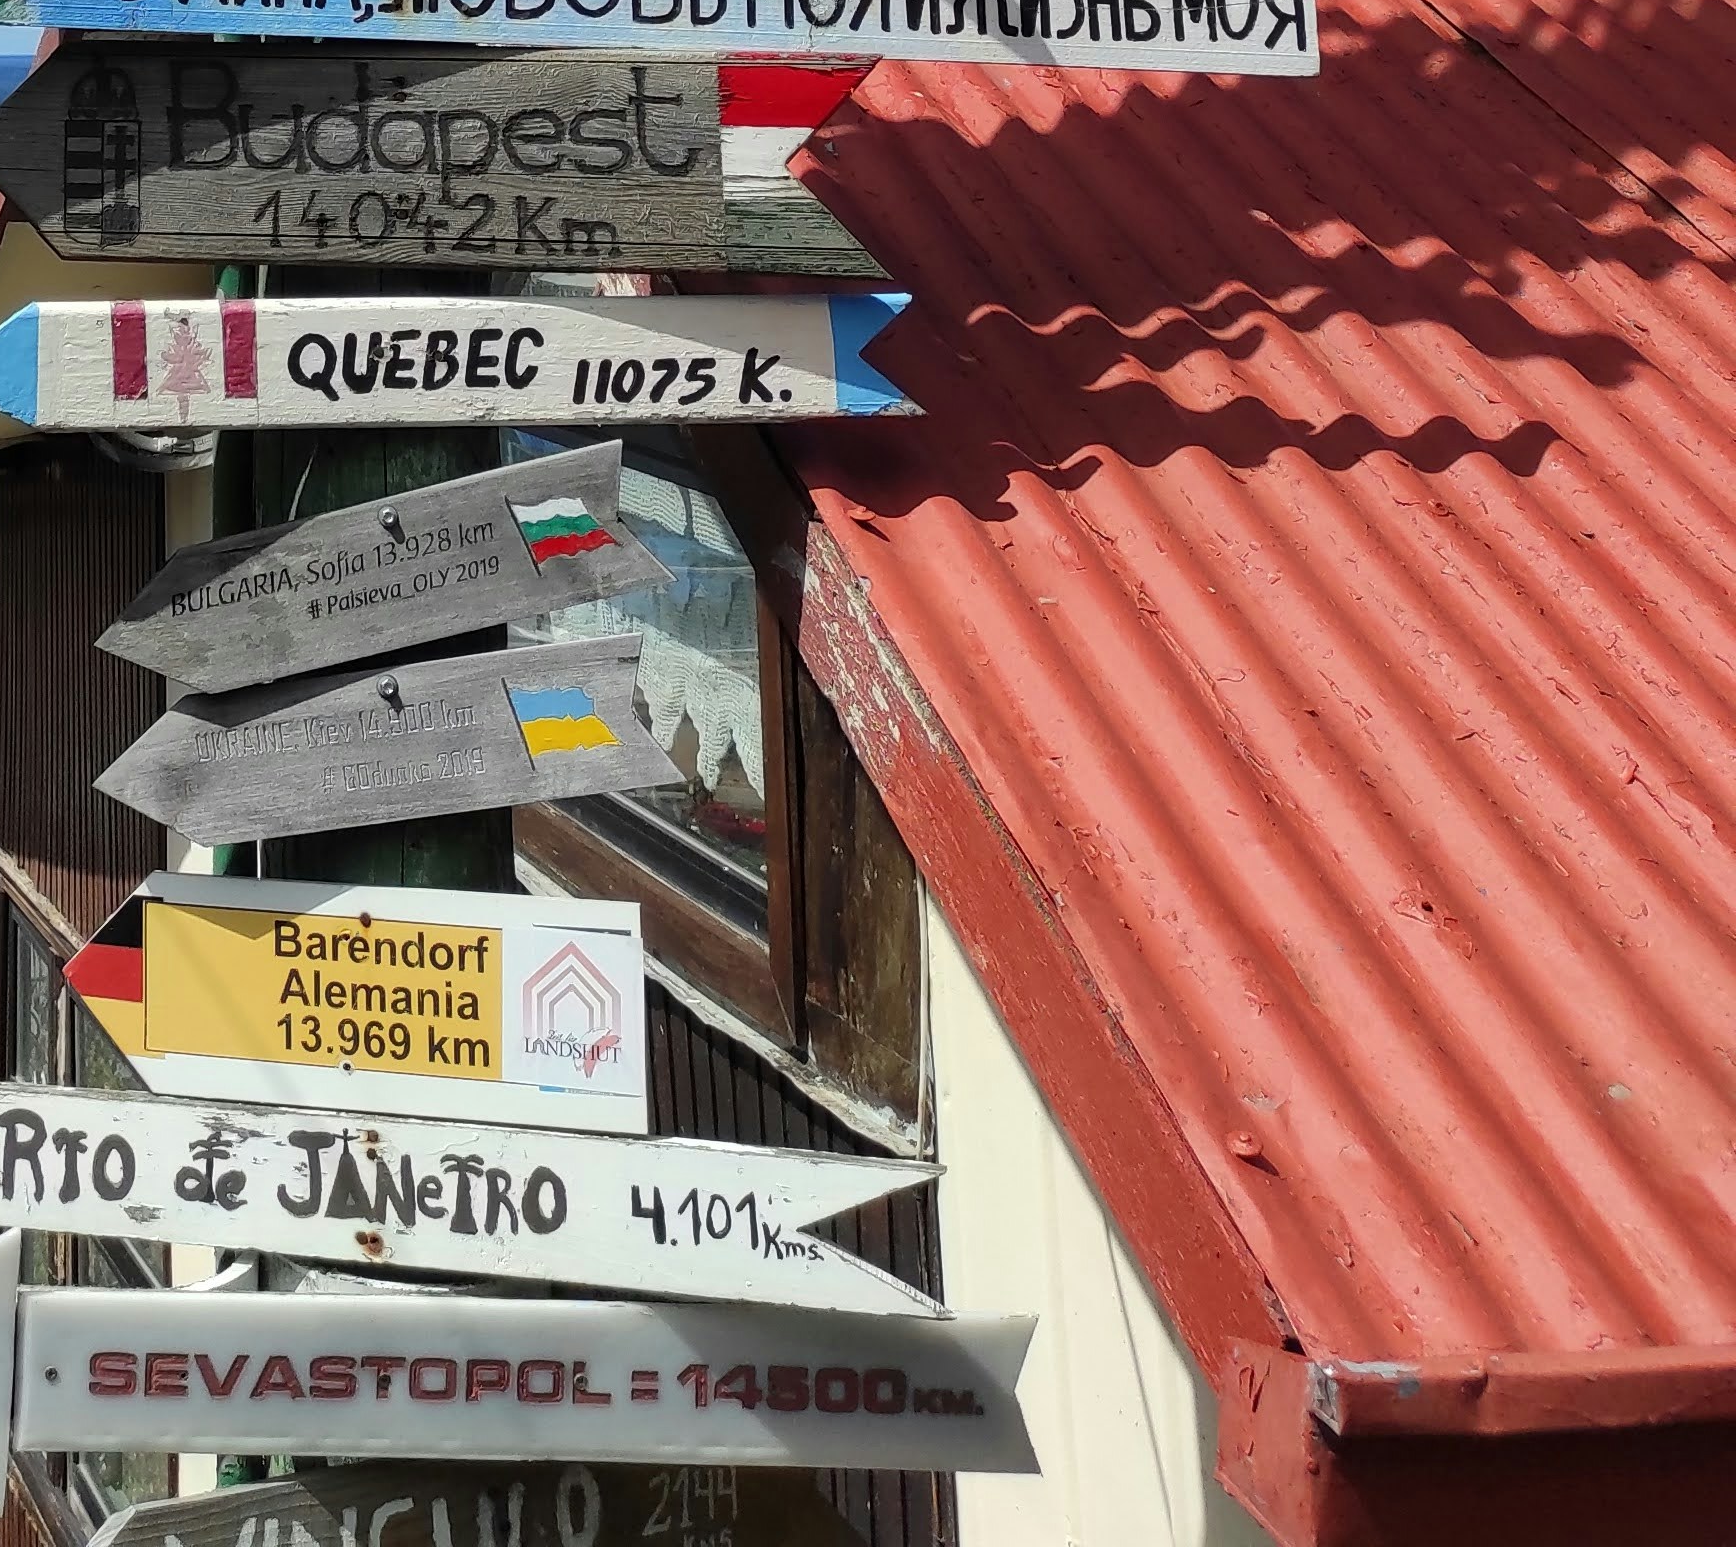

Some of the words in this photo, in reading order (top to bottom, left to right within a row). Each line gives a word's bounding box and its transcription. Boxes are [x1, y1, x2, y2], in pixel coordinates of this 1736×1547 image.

[167, 59, 703, 206] Budapest
[253, 188, 498, 254] 14042
[515, 196, 622, 259] Km
[286, 327, 546, 403] QUEBEC
[573, 357, 717, 407] 11075
[737, 348, 794, 405] K.
[171, 566, 300, 618] BULGARIA,
[306, 550, 365, 585] Sofia
[372, 528, 451, 568] 13.928
[458, 522, 494, 548] km
[455, 556, 500, 582] 2019
[304, 717, 351, 748] Kiev
[440, 699, 477, 729] km
[437, 746, 486, 780] 2019
[273, 919, 490, 975] Barendorf
[279, 967, 480, 1021] Alemania
[277, 1013, 412, 1061] 13.969
[428, 1025, 491, 1068] km
[524, 1036, 622, 1063] LANDSHUT
[87, 1351, 613, 1407] SEVASTOPOL
[676, 1361, 908, 1416] 14500
